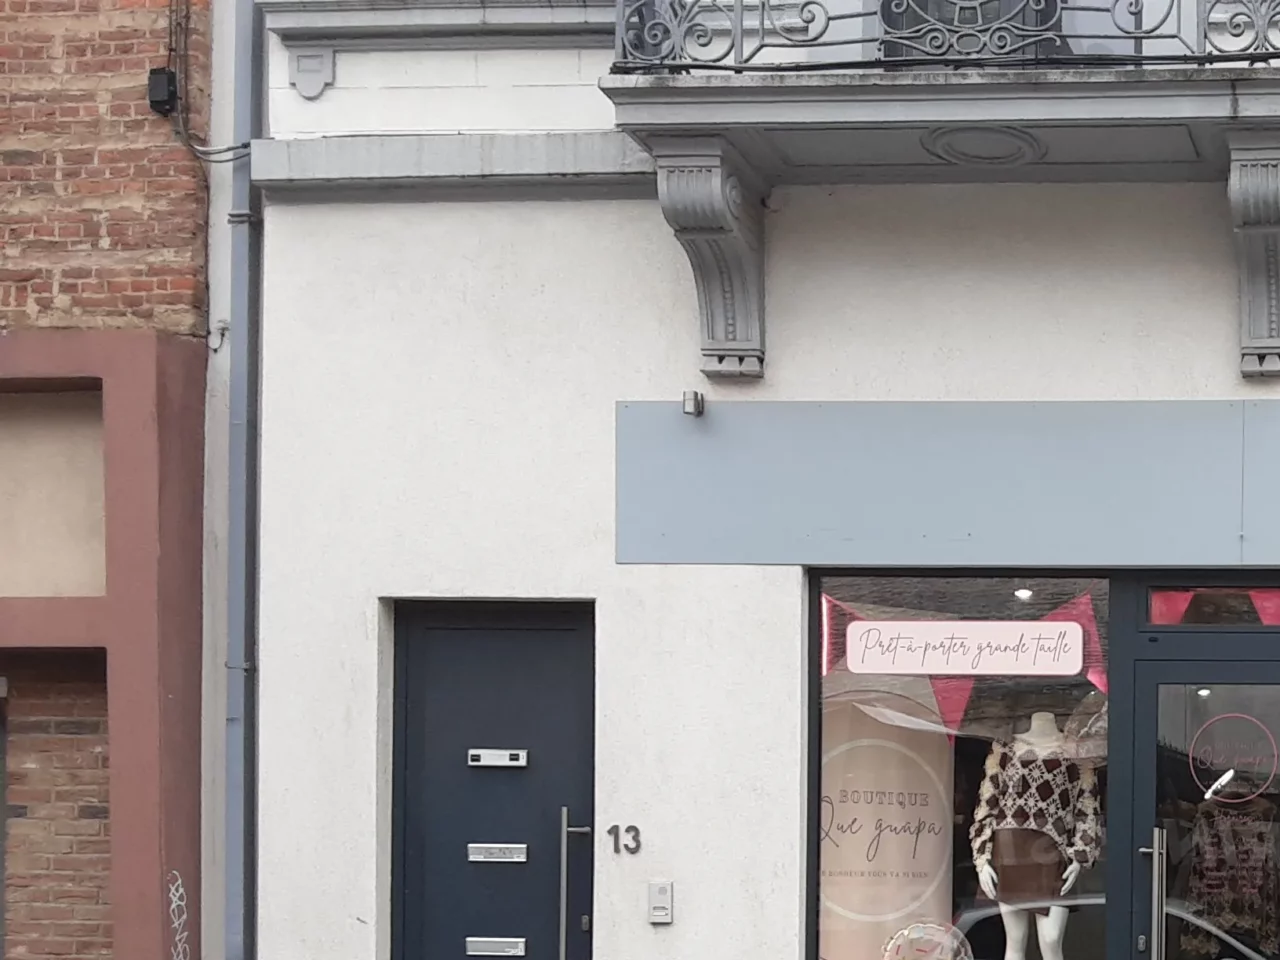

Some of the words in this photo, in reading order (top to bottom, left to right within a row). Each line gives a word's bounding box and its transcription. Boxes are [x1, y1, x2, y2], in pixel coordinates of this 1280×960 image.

[972, 629, 1030, 669] grande
[838, 789, 930, 808] BOUTIQUE
[606, 824, 641, 854] 13
[820, 795, 864, 848] Que
[866, 816, 942, 862] guapa
